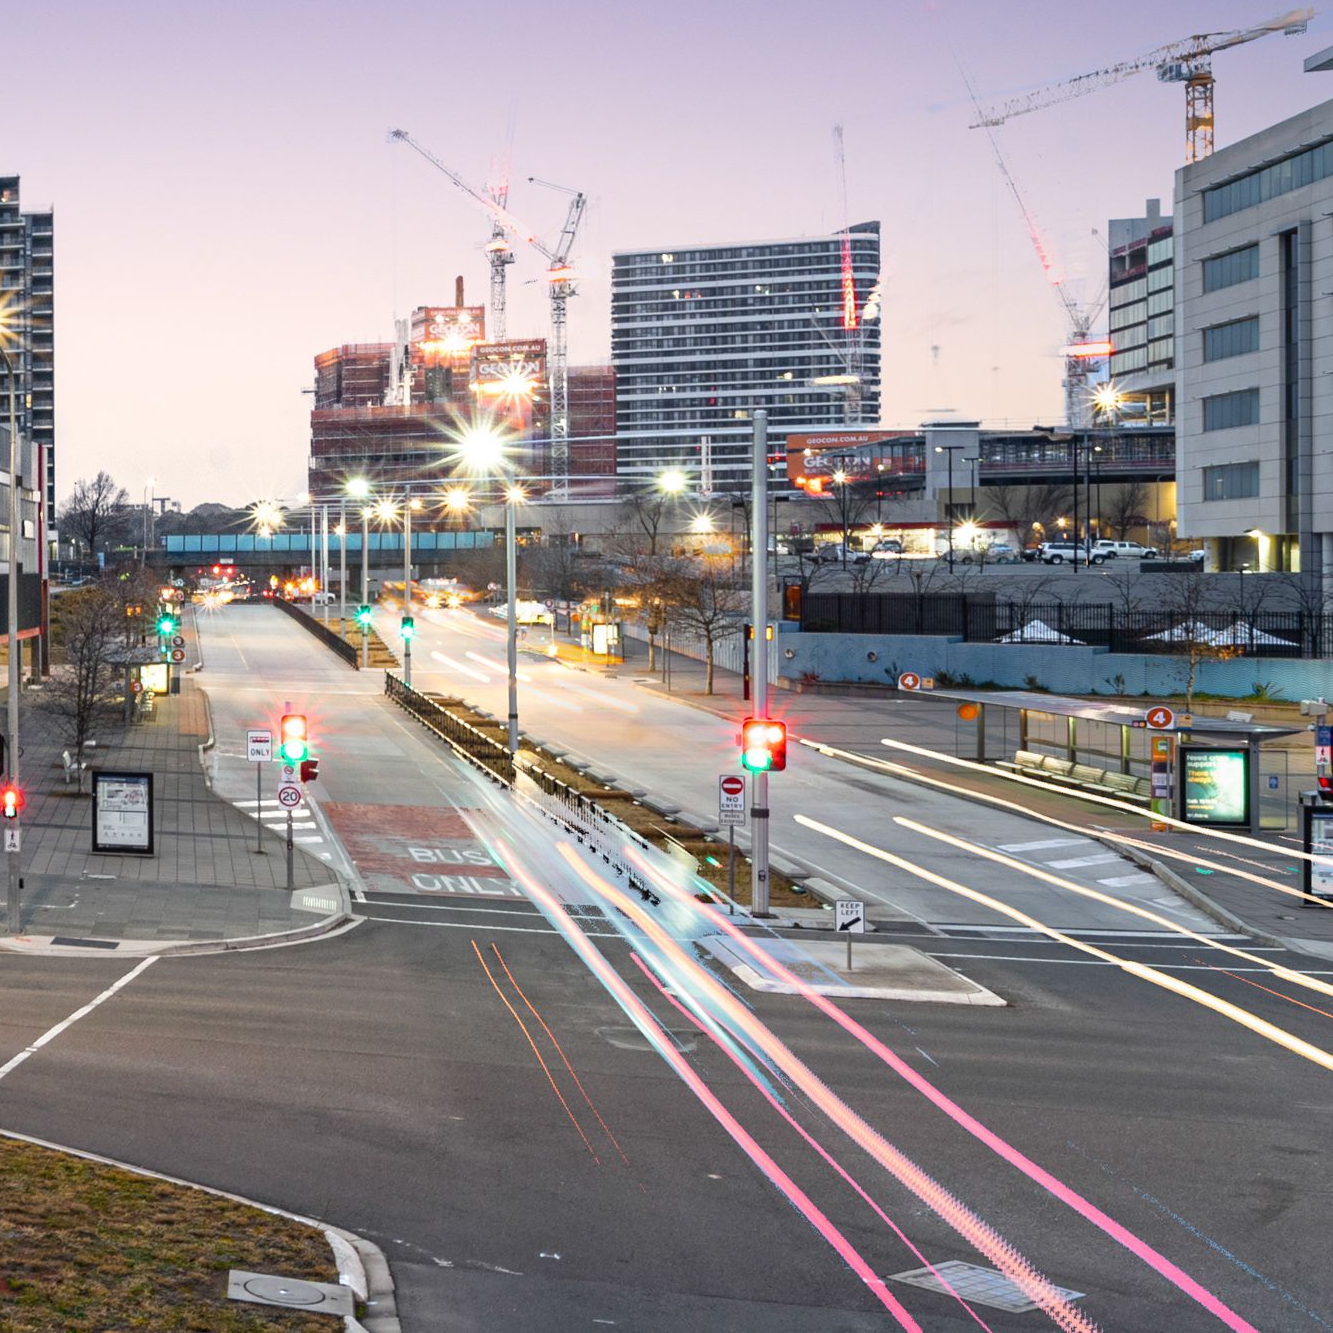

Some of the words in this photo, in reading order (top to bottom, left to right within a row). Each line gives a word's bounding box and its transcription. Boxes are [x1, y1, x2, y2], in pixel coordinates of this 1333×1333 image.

[806, 435, 869, 444] GEOCON.COM.AU
[1153, 711, 1166, 724] 4
[250, 748, 270, 756] ONLY
[282, 791, 298, 801] 20
[408, 847, 492, 865] BUS
[411, 873, 522, 896] ONLY
